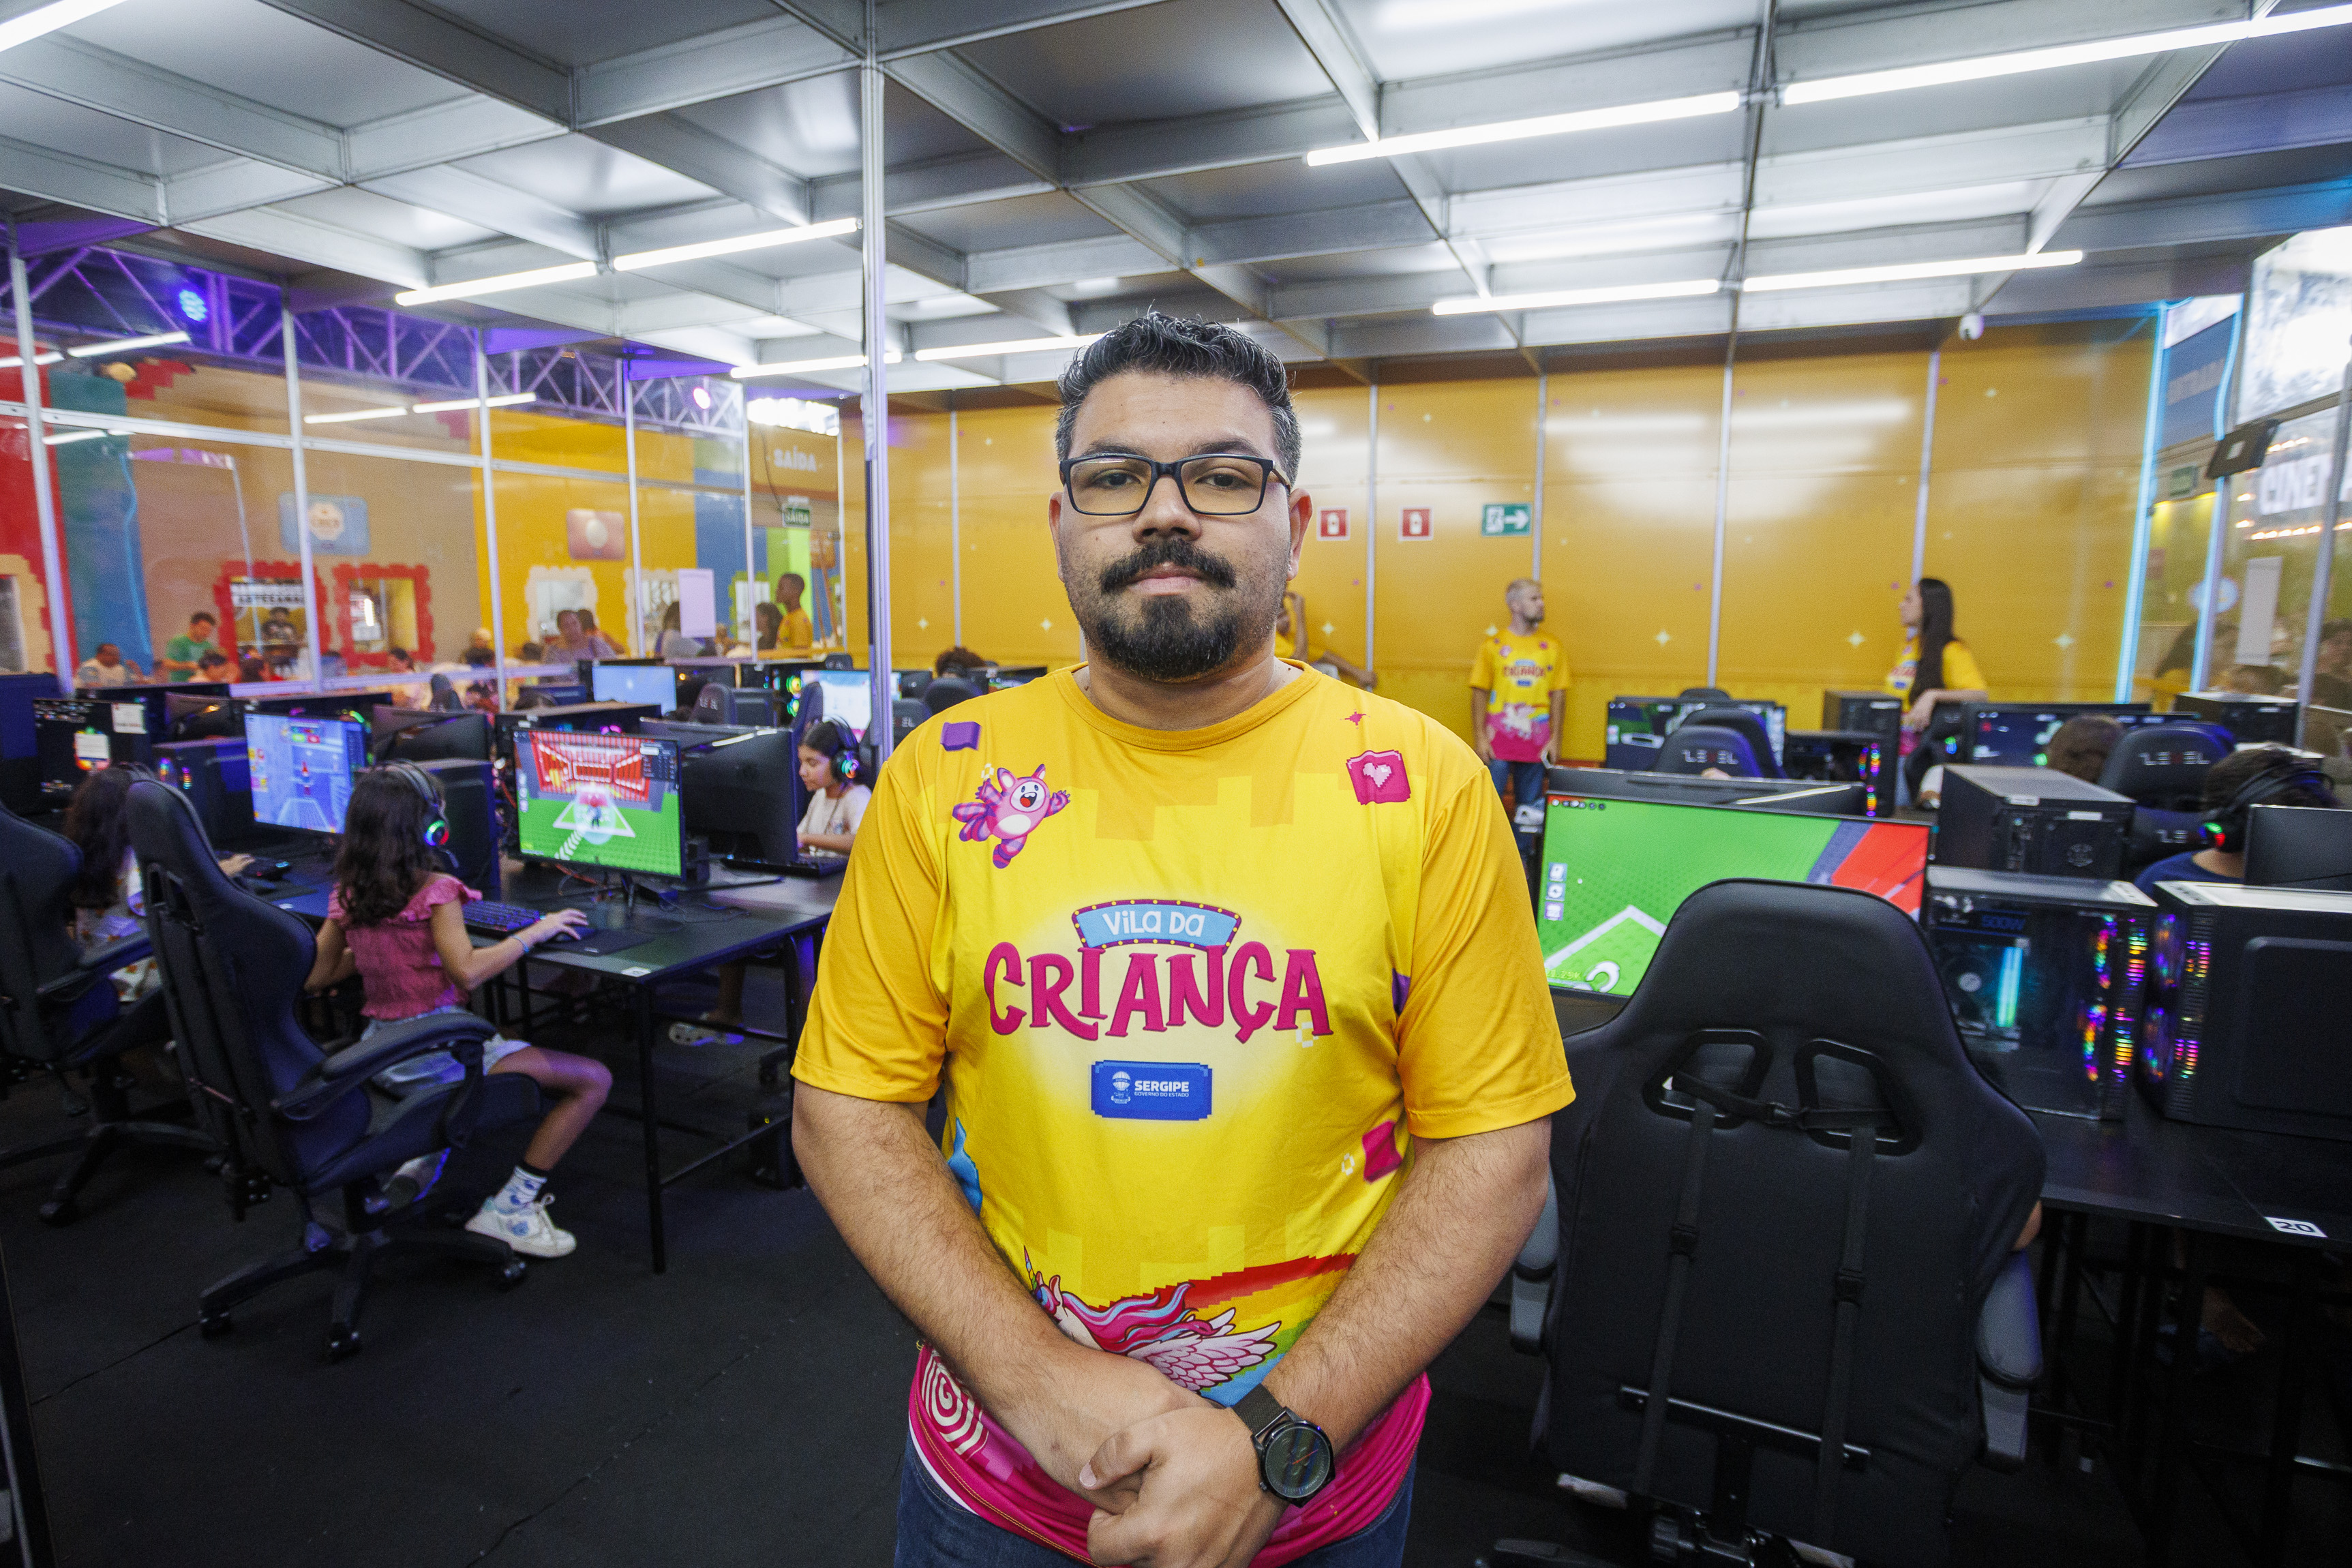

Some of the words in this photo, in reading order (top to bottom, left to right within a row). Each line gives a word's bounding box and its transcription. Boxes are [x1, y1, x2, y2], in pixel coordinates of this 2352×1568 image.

[773, 446, 817, 472] SAÍDA
[1681, 749, 1738, 765] LEVEL
[2138, 751, 2210, 766] LEVEL
[984, 941, 1334, 1044] CRIANÇA
[1134, 1081, 1189, 1092] SERGIPE
[2274, 1221, 2315, 1233] 20
